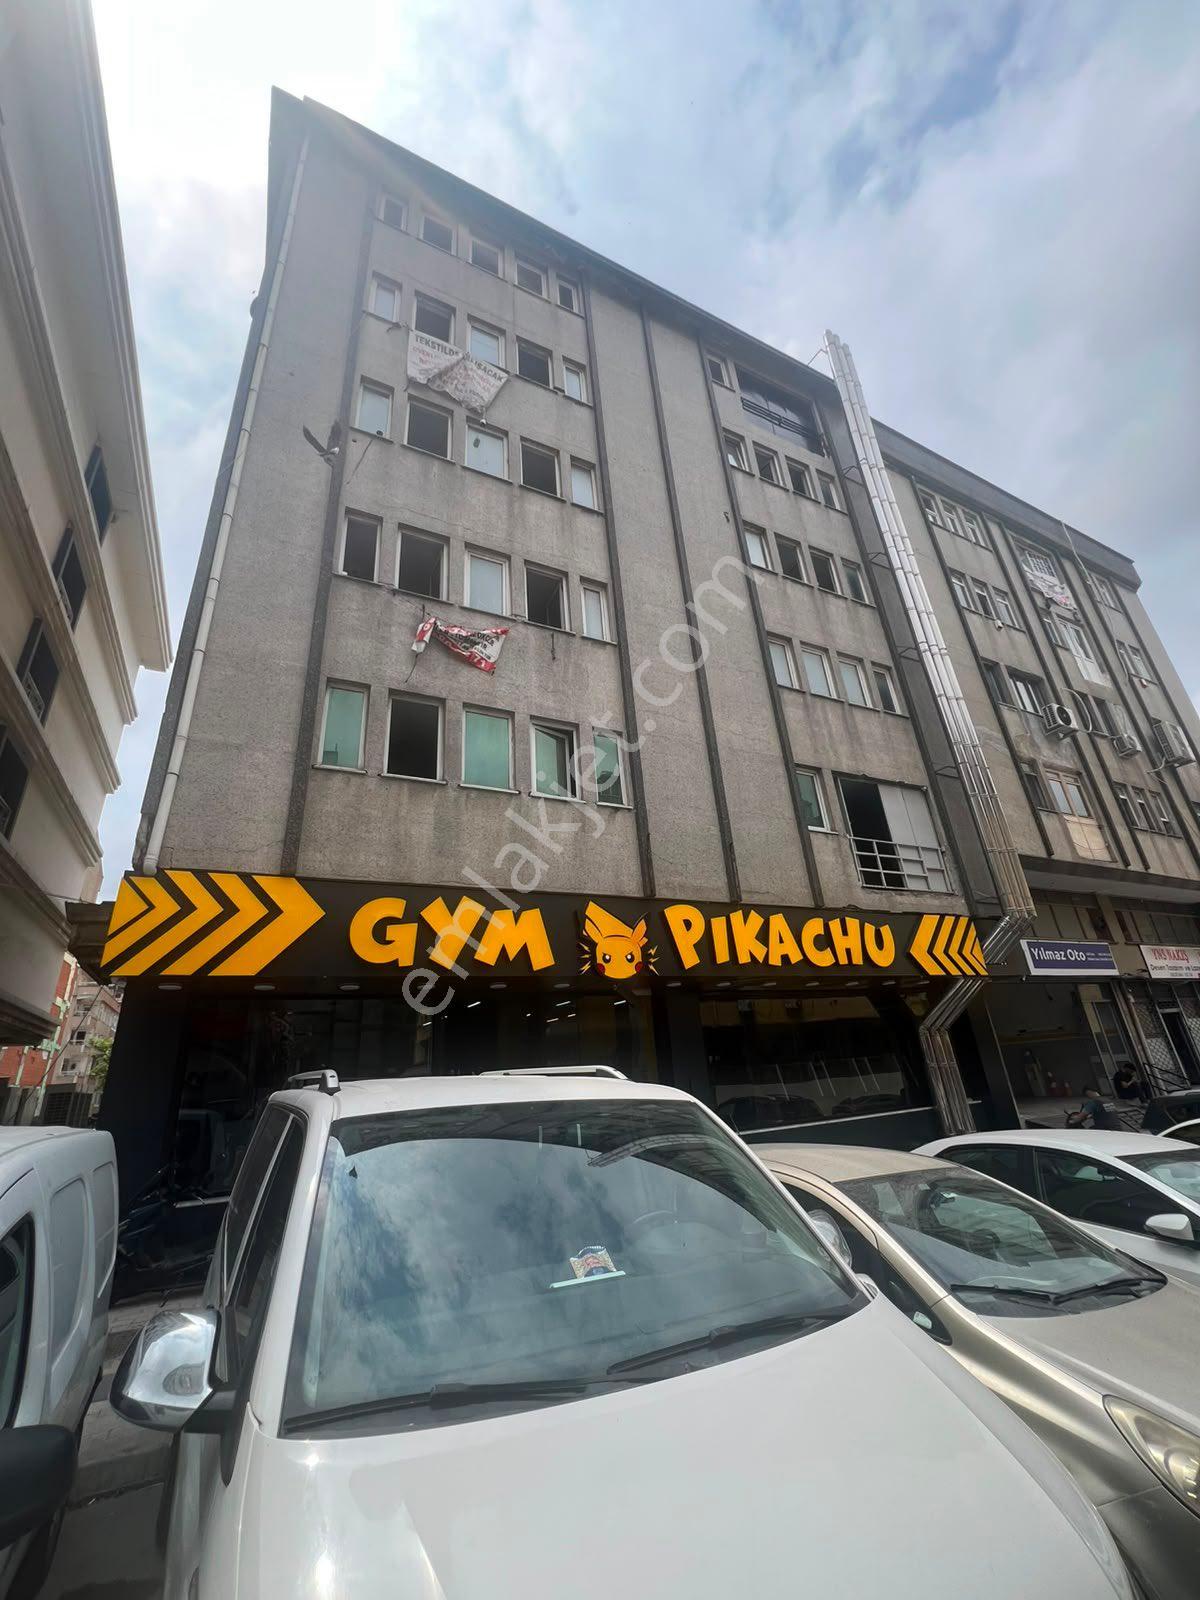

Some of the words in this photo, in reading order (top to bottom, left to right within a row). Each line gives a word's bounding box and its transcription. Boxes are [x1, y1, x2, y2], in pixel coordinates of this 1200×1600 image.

[349, 894, 555, 972] GYM
[663, 903, 896, 970] PIKACHU
[1030, 947, 1067, 961] Yılmaz
[1066, 948, 1086, 961] Oto
